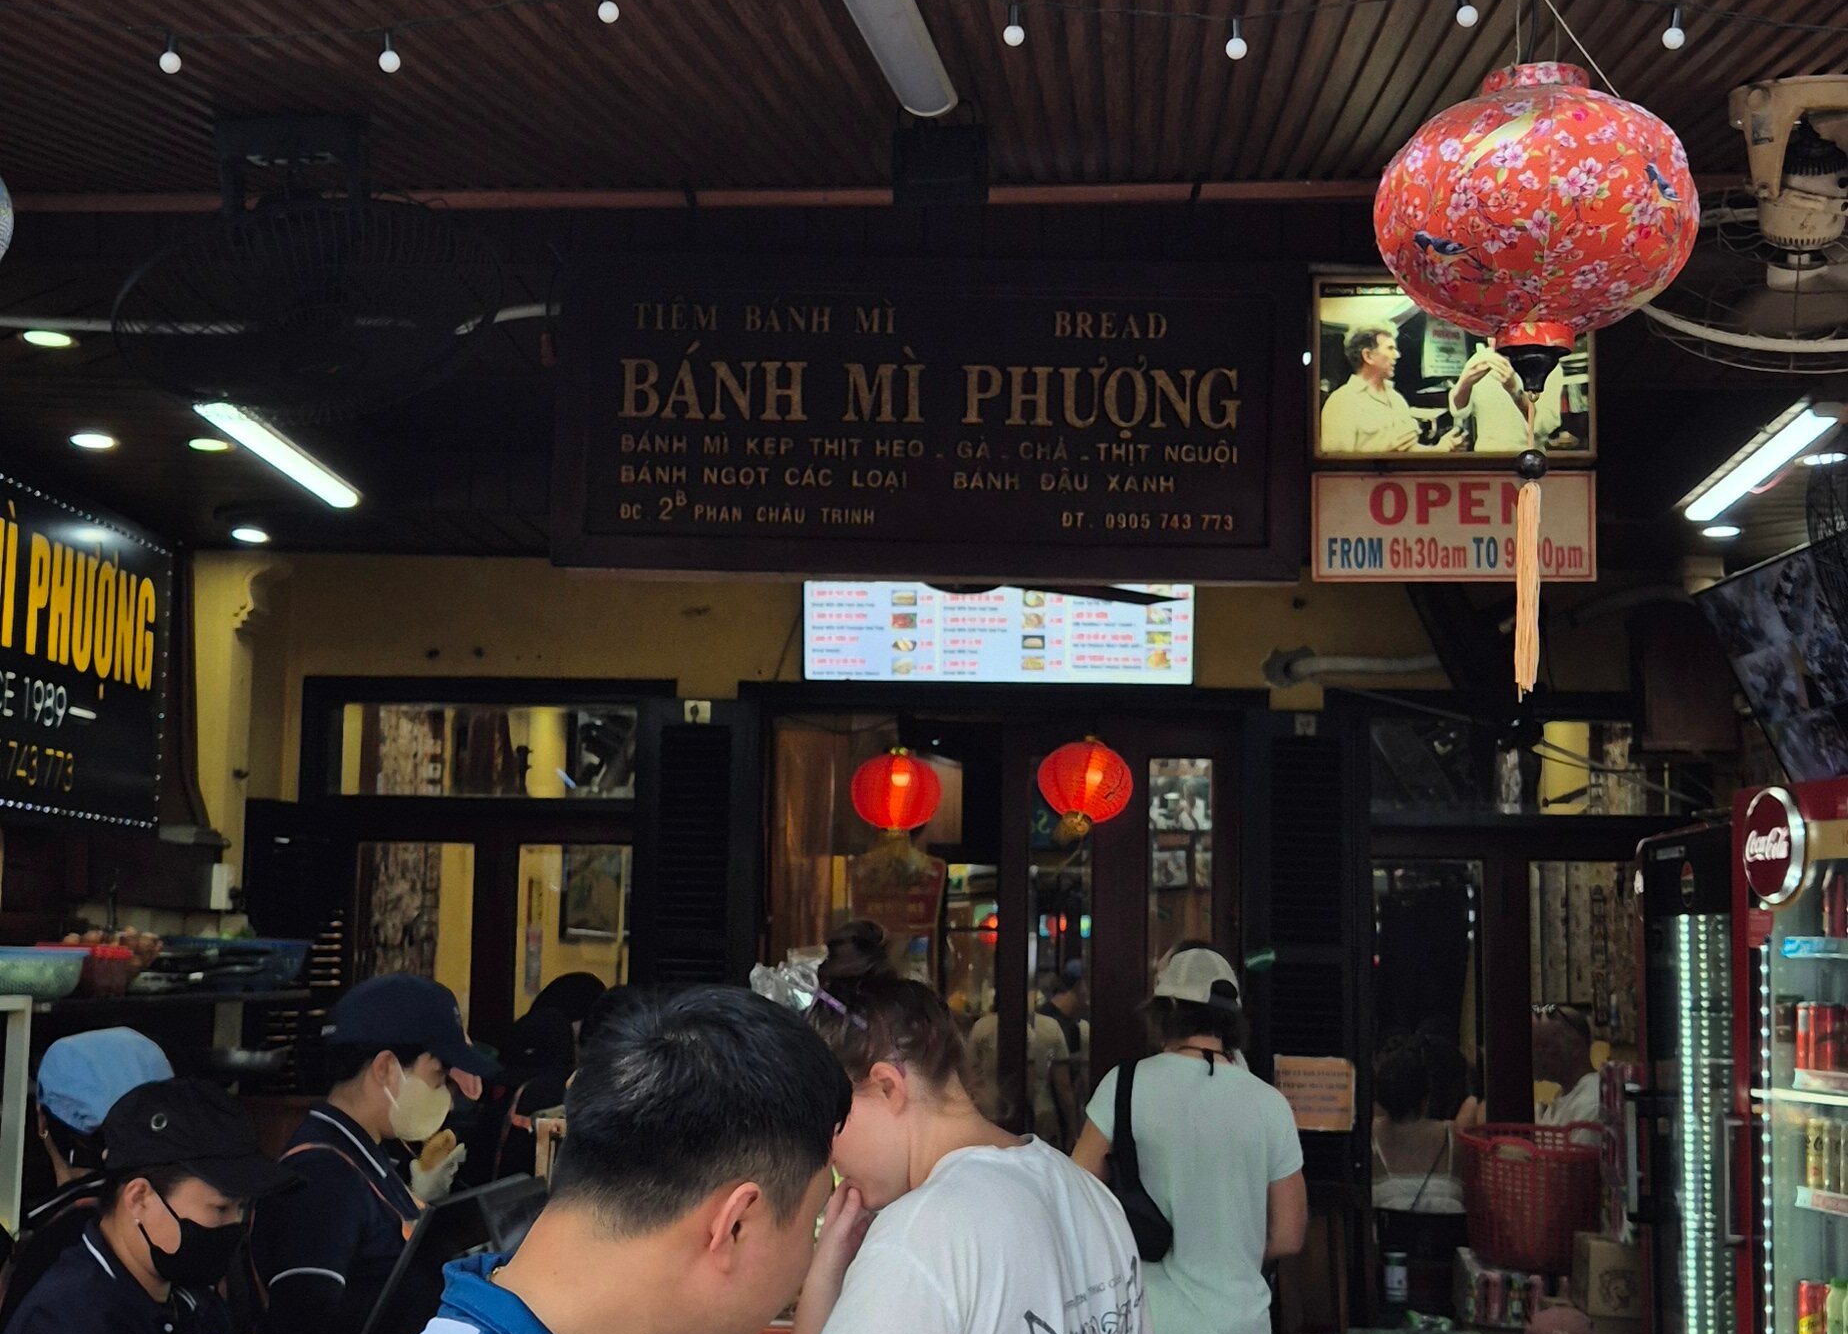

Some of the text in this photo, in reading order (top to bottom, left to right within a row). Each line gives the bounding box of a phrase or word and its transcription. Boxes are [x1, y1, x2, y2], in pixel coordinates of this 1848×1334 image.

[745, 297, 832, 333] BÁNH
[855, 299, 896, 334] MÌ
[1054, 310, 1168, 339] BREAD
[617, 340, 1242, 439] BÁNH MÌ PHƯỢNG
[621, 428, 688, 454] BÁNH
[703, 429, 729, 454] MÌ
[809, 438, 862, 460] THỊT
[875, 439, 925, 458] HEO
[1096, 443, 1151, 467] THỊT
[620, 460, 908, 494] BÁNH NGỌT CÁC LOẠI
[1107, 473, 1176, 493] XANH
[694, 504, 742, 522] PHAN
[755, 502, 806, 524] CHÂU
[820, 507, 875, 525] TRINH
[1104, 512, 1150, 530] 0905
[1159, 514, 1192, 530] 743
[1201, 514, 1234, 531] 773
[1328, 537, 1583, 574] FROM 6h30am TO 90pm
[0, 499, 156, 700] Ì PHƯỢNG
[24, 676, 67, 729] 1989
[44, 747, 74, 793] 773
